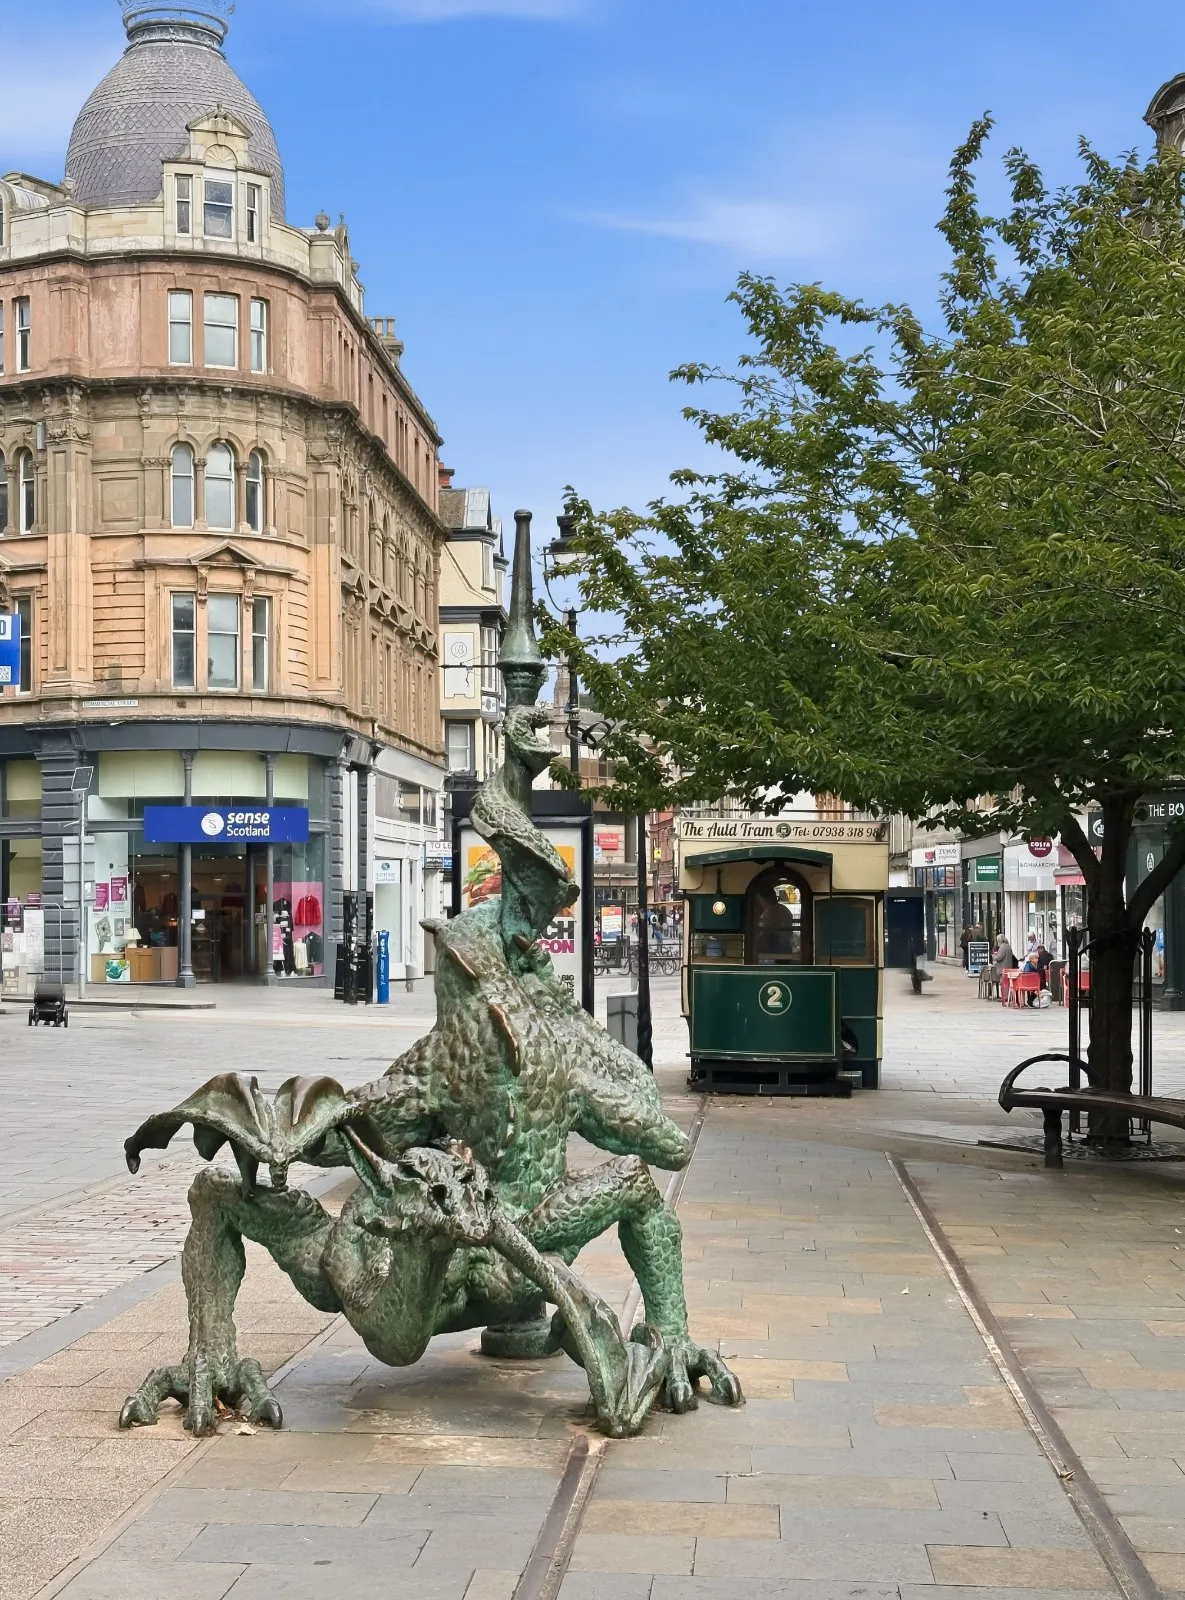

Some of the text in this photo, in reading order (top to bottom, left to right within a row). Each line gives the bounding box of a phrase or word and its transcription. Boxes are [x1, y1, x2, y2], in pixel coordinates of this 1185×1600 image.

[1148, 803, 1185, 817] THE BO
[226, 812, 270, 824] sense
[226, 825, 270, 837] Scotland
[682, 822, 704, 836] The
[707, 822, 738, 837] Auld
[741, 822, 774, 837] Tram
[793, 826, 810, 837] Tel:
[812, 826, 845, 837] 07938
[847, 827, 864, 837] 318
[442, 842, 452, 850] LE
[541, 920, 575, 940] CH
[538, 940, 575, 954] CON
[767, 986, 783, 1008] 2
